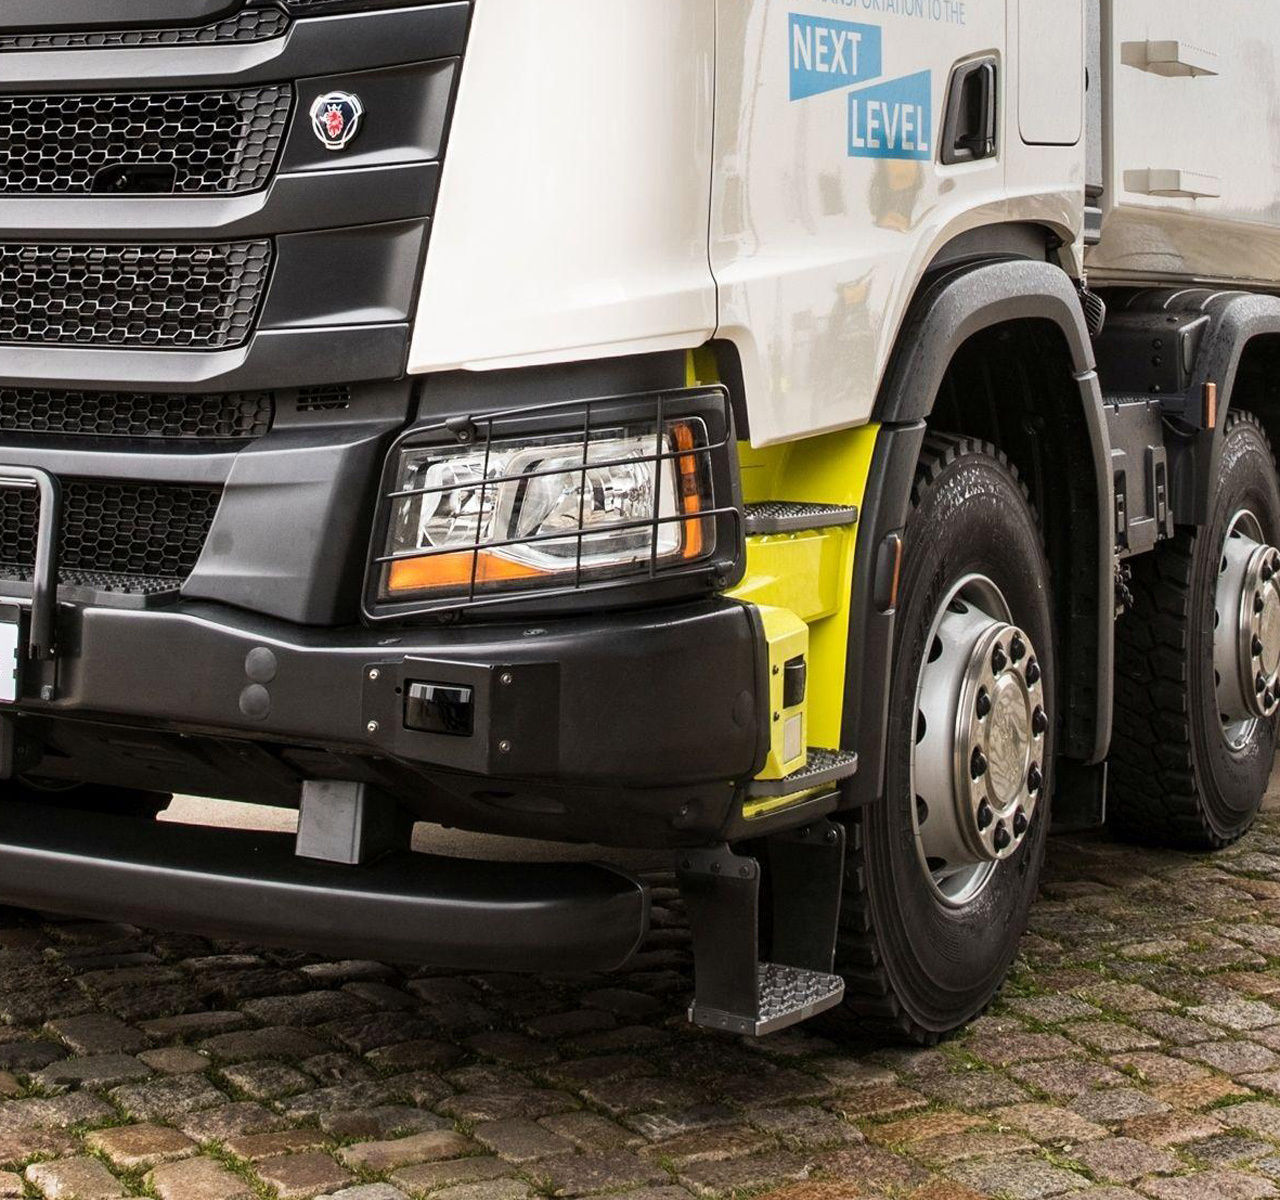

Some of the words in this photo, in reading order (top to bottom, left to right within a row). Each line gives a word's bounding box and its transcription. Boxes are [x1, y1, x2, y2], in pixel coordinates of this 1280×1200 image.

[944, 0, 966, 25] THE
[793, 23, 862, 75] NEXT
[852, 99, 928, 152] LEVEL
